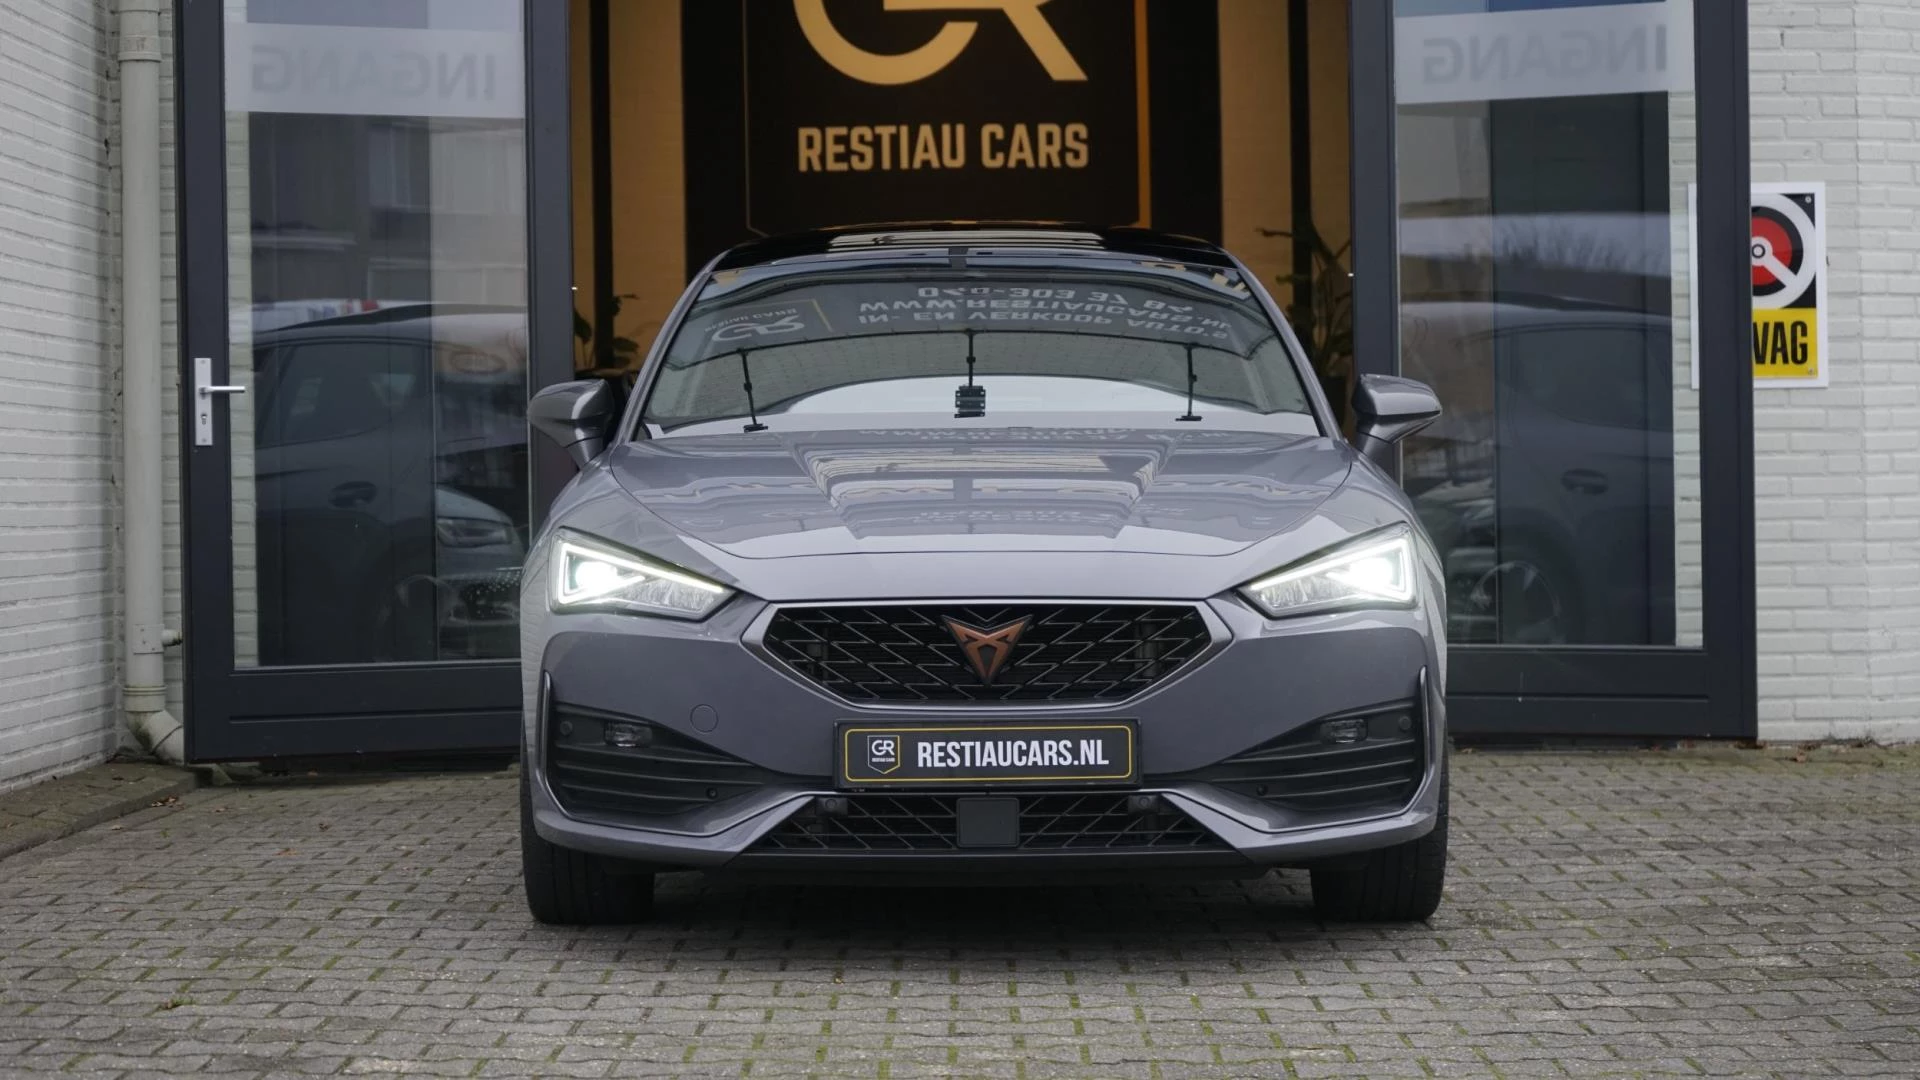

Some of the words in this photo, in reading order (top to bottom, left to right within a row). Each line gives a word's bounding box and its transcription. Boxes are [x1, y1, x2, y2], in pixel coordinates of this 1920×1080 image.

[798, 123, 966, 173] RESTIAU
[981, 123, 1089, 169] CARS
[917, 739, 1109, 768] RESTIAUCARS.NL
